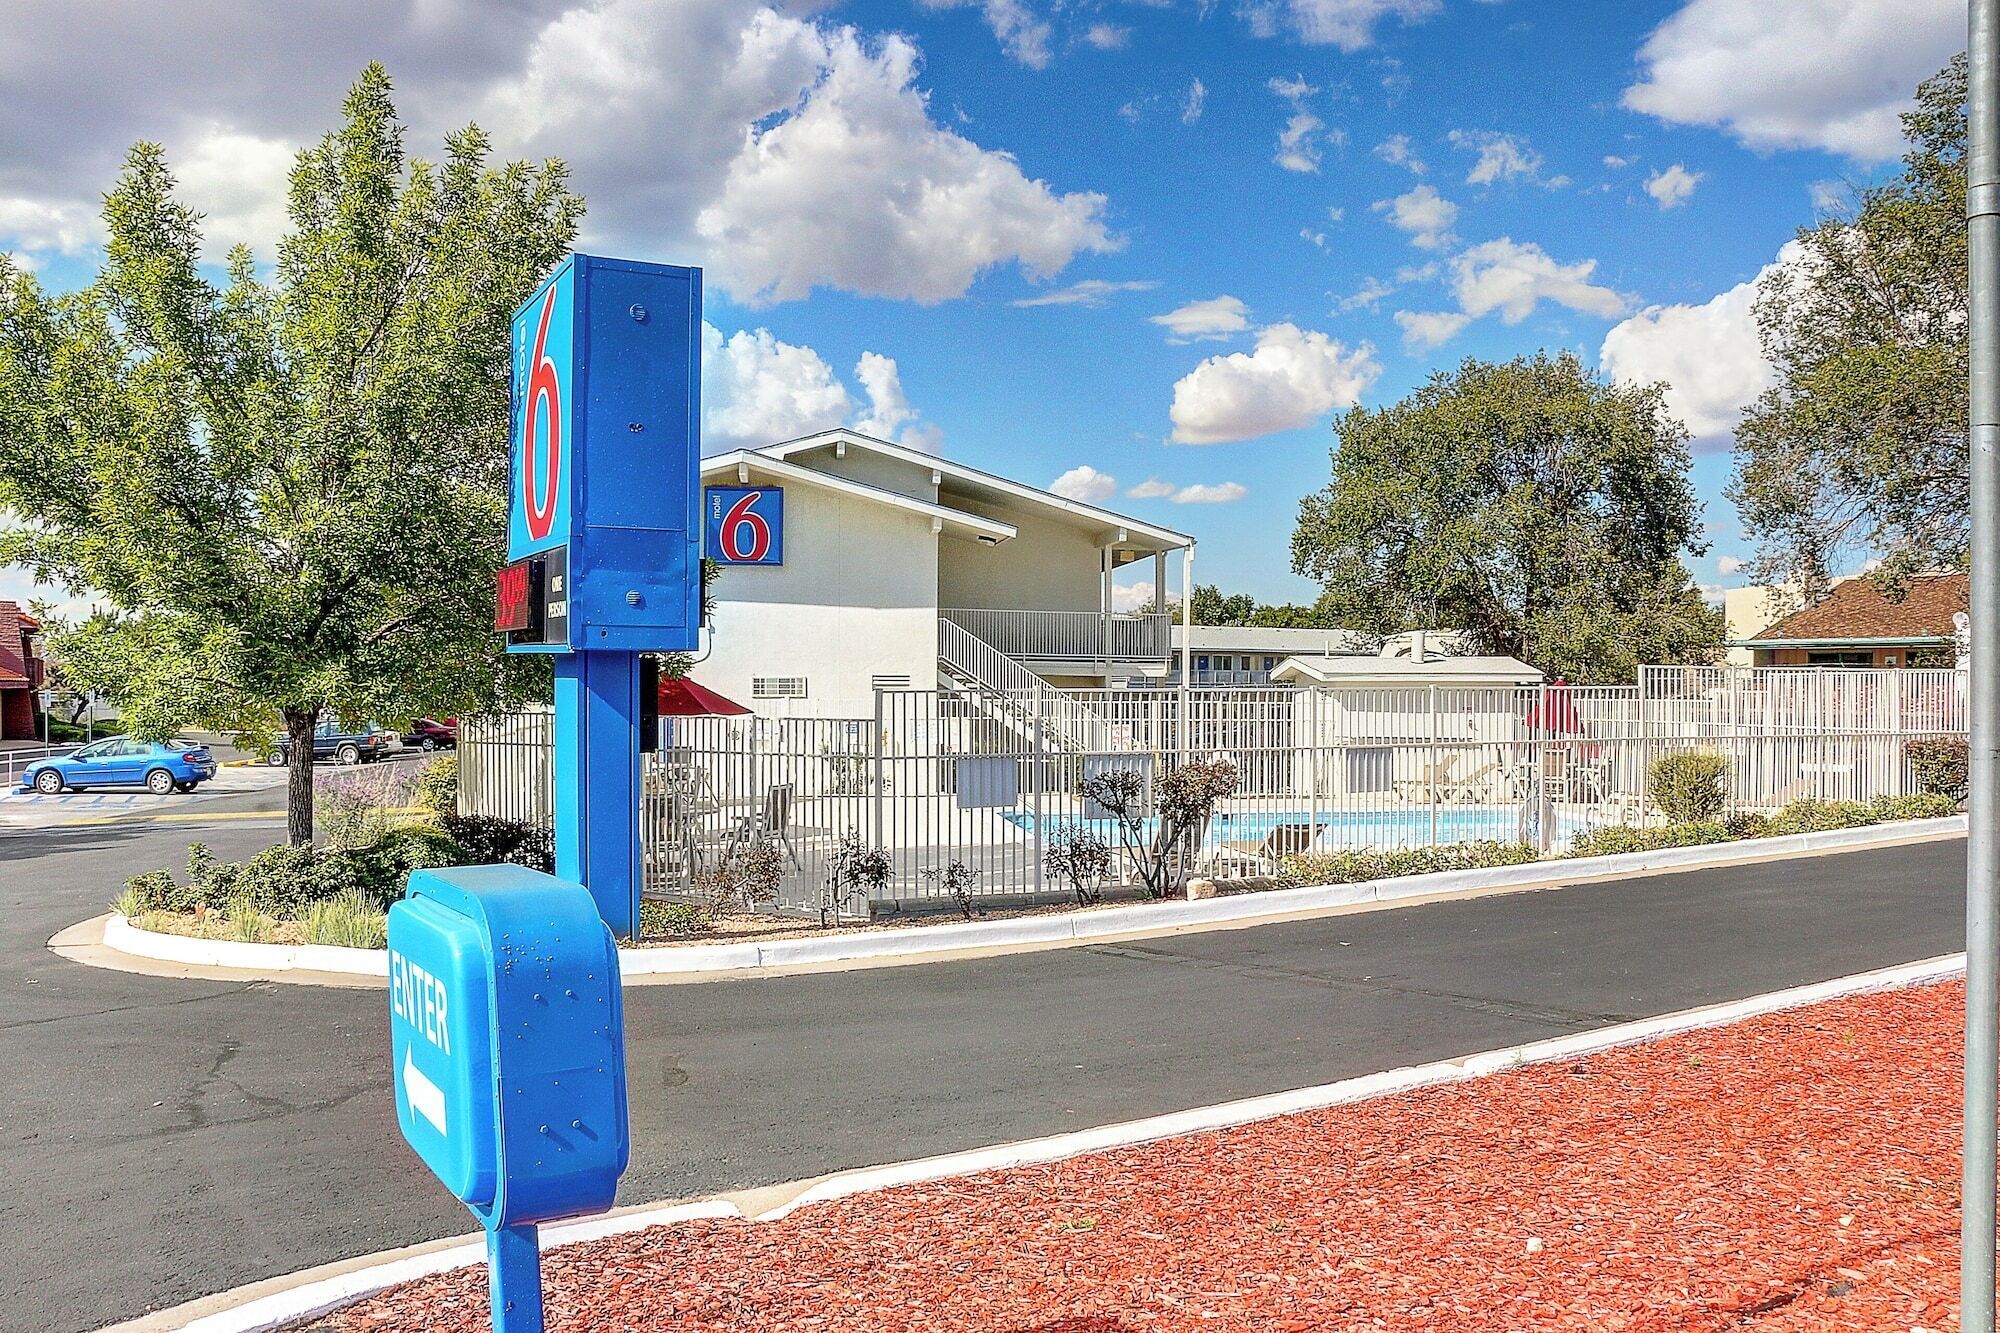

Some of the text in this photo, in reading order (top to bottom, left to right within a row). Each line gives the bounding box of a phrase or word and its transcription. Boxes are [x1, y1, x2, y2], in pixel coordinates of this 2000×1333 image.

[522, 281, 561, 541] 6
[712, 495, 721, 519] motel
[719, 491, 771, 561] 6
[551, 575, 563, 593] ONE
[547, 601, 567, 619] PERSON
[391, 949, 452, 1057] ENTER
